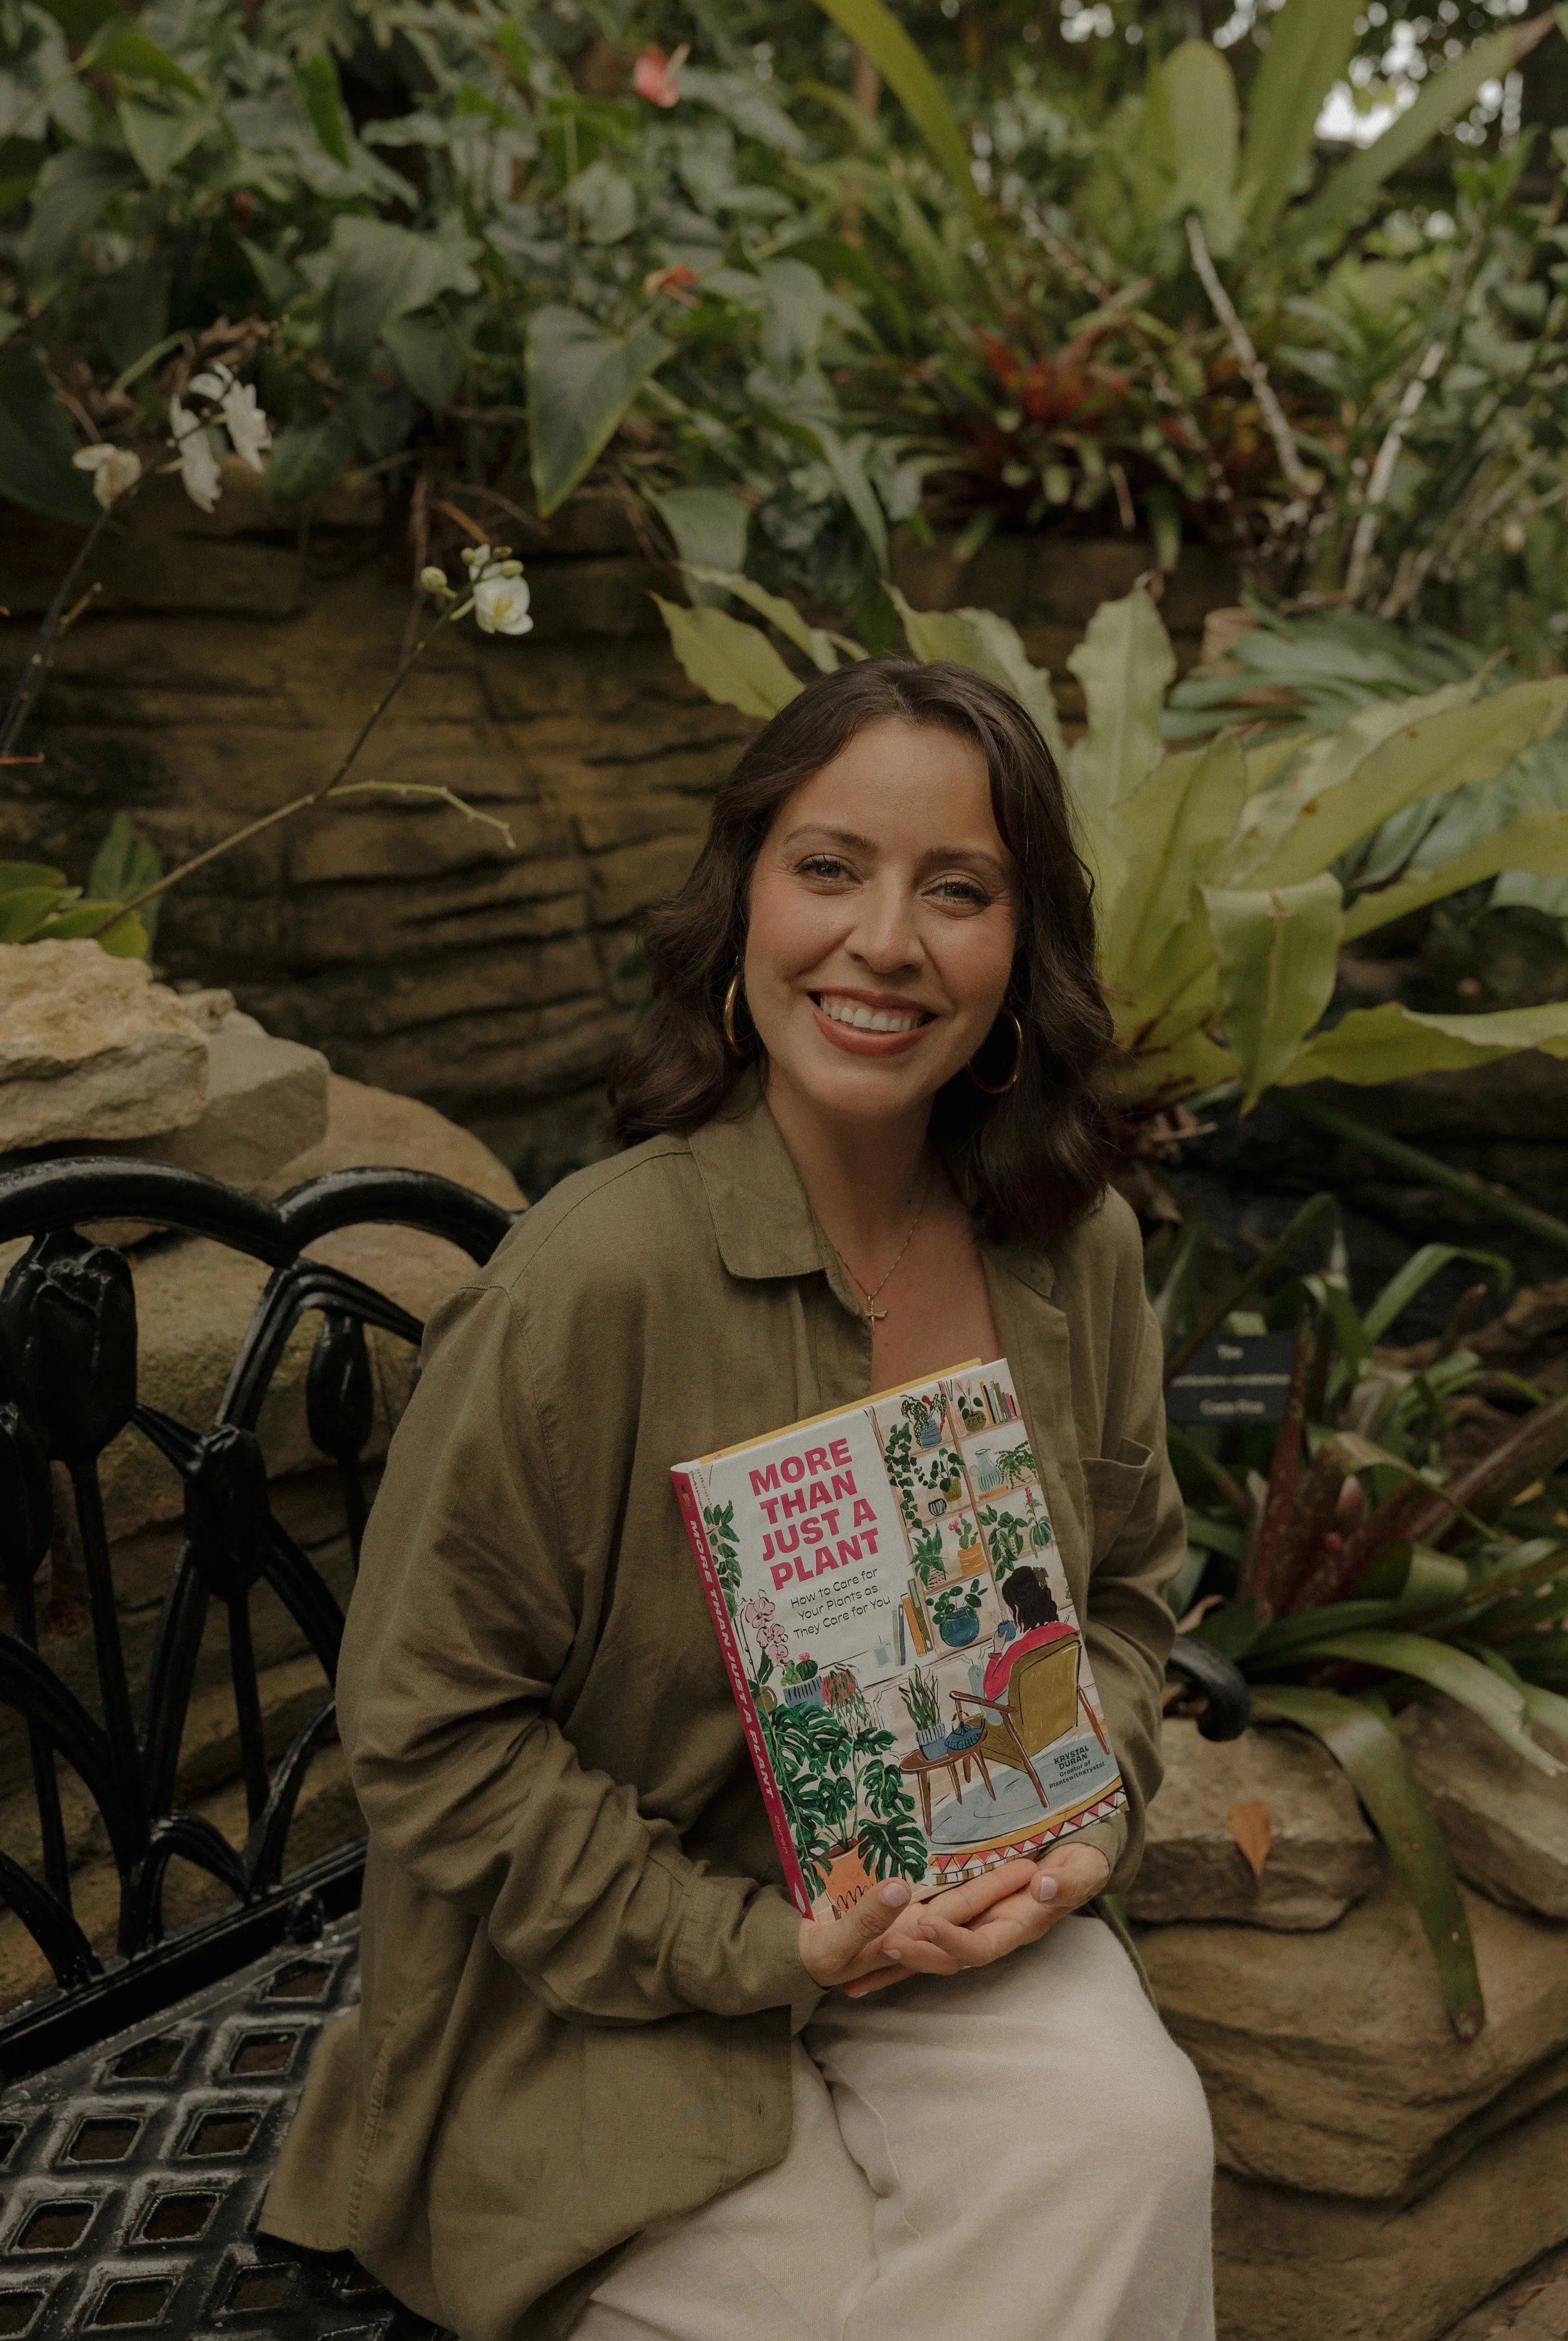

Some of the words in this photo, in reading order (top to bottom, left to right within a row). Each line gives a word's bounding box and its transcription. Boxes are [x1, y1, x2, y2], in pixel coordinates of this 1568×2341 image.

[749, 1438, 852, 1496] MORE
[760, 1470, 857, 1525] THAN
[763, 1508, 840, 1561] JUST
[853, 1498, 877, 1527] A
[770, 1527, 879, 1591] PLANT
[790, 1592, 816, 1608] How
[818, 1588, 830, 1597] to
[833, 1576, 859, 1591] Care
[861, 1568, 877, 1581] for
[798, 1605, 824, 1621] Your
[826, 1591, 862, 1610] Plants
[864, 1585, 878, 1596] as
[793, 1623, 820, 1638] They
[823, 1613, 850, 1627] Care
[851, 1604, 868, 1617] for
[869, 1596, 891, 1609] You
[690, 1521, 713, 1583] MORE
[709, 1588, 731, 1647] THAN
[727, 1652, 748, 1705] JUST
[743, 1709, 753, 1723] A
[750, 1729, 774, 1799] PLANT
[775, 1815, 788, 1854] Duran
[1049, 1761, 1105, 1788] PlantswithKrystal
[1054, 1745, 1089, 1765] KRYSTAL
[1059, 1753, 1088, 1770] DURAN
[1059, 1764, 1084, 1776] Creator
